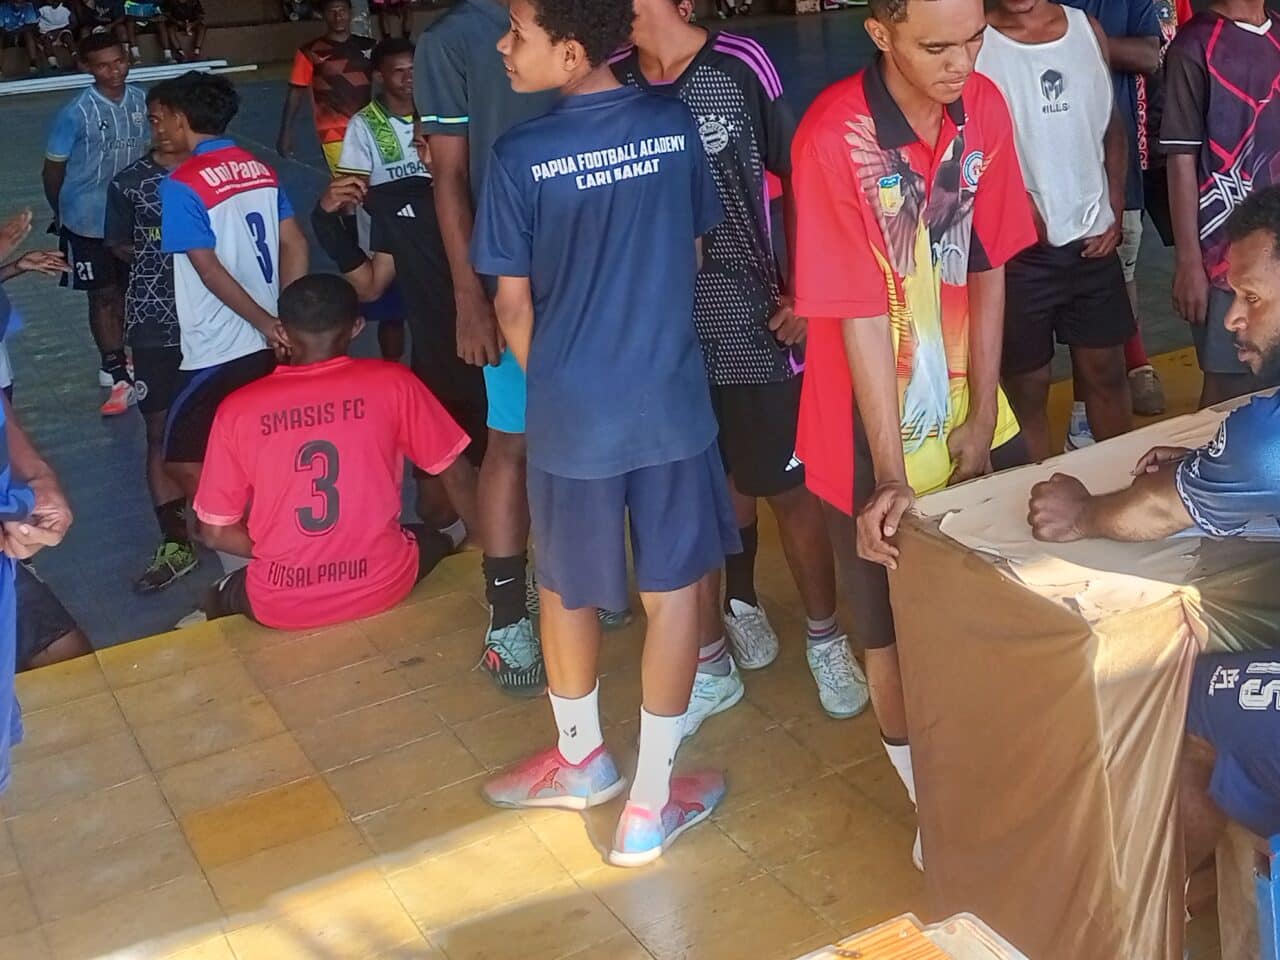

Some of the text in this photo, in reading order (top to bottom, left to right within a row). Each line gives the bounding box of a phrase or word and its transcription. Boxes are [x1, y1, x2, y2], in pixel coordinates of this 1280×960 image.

[199, 162, 233, 187] Uni
[531, 135, 685, 182] PAPUA FOOTBALL ACADEMY
[575, 169, 613, 190] CARI
[245, 211, 274, 284] 3
[76, 261, 95, 281] 21
[260, 398, 366, 436] SMASIS FC
[294, 439, 340, 538] 3
[267, 558, 368, 588] FUTSAL PAPUA
